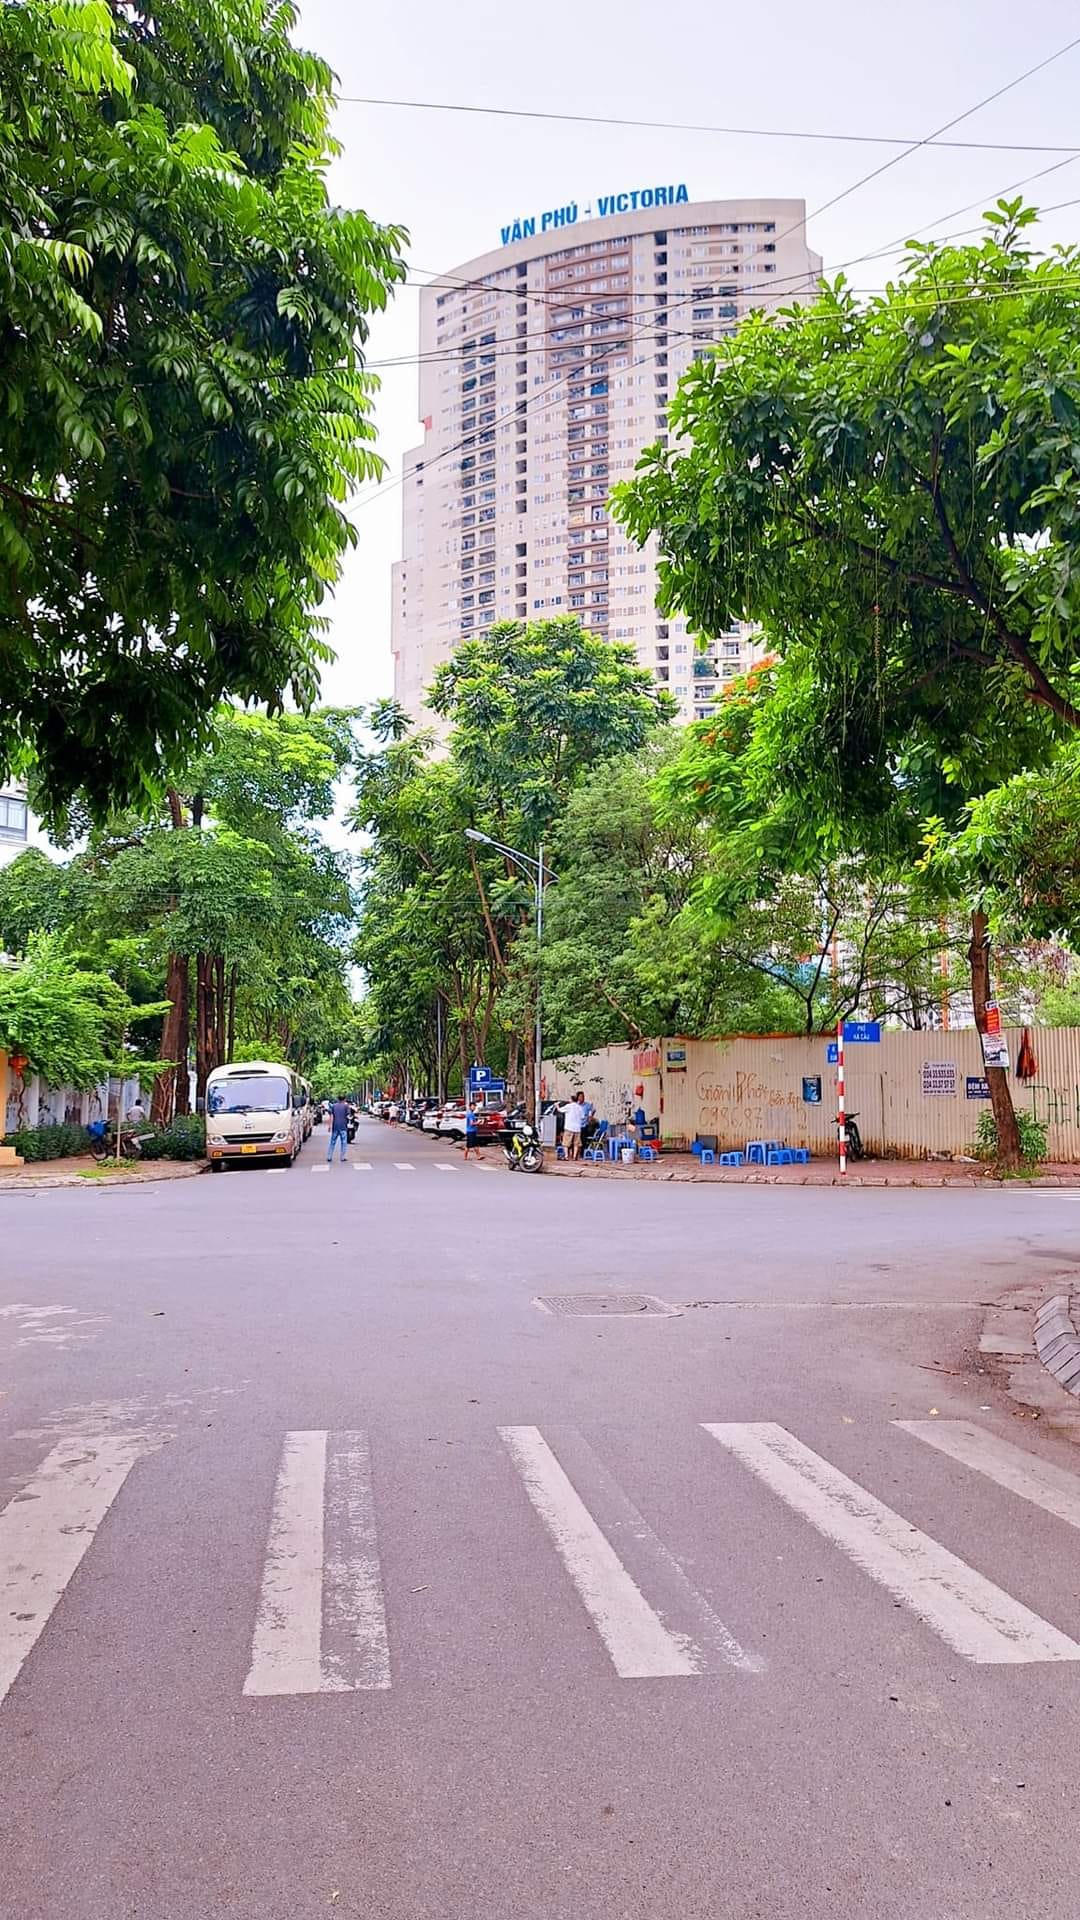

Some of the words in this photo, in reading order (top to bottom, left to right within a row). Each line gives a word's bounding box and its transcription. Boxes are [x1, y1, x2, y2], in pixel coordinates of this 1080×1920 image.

[500, 217, 536, 246] VĂN
[541, 200, 578, 232] PHÚ
[597, 183, 689, 217] VICTORIA
[476, 1070, 486, 1081] P
